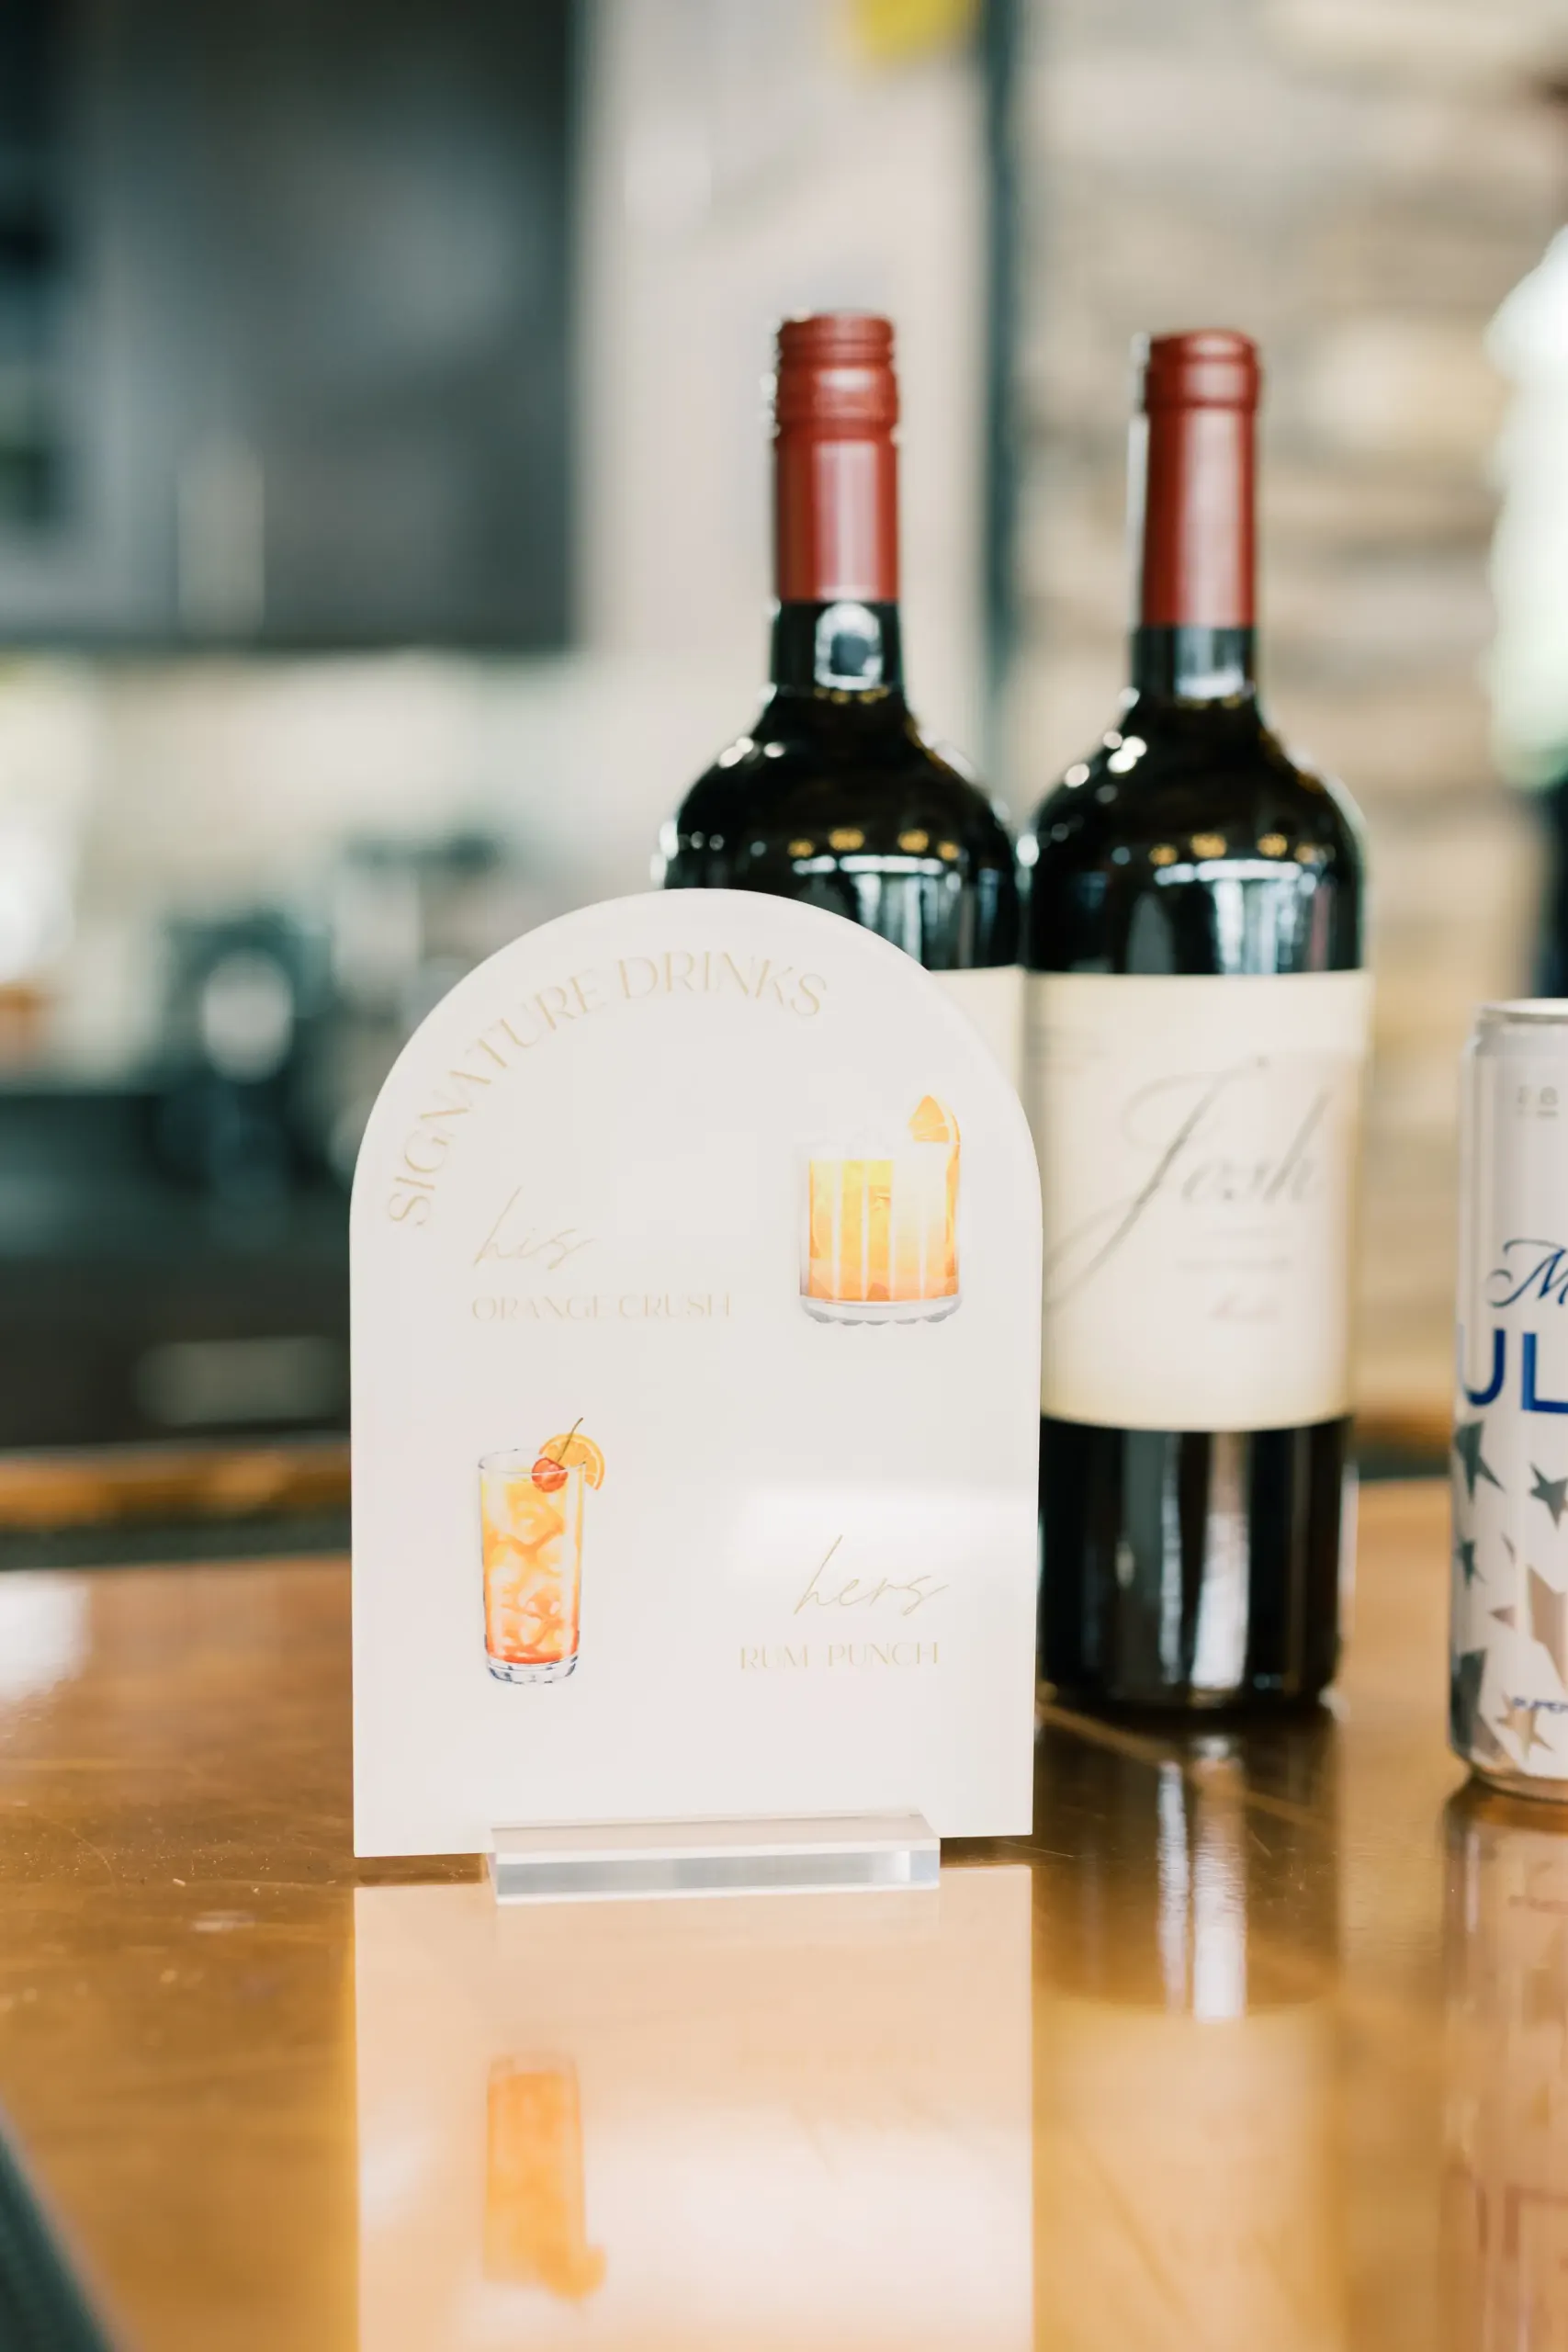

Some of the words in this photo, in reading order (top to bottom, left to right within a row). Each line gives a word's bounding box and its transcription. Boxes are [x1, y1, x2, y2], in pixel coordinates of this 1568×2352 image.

[387, 968, 606, 1227] SIGNATURE
[615, 950, 828, 1017] DRINKS
[472, 1185, 596, 1270] his
[471, 1295, 604, 1320] ORANGE
[618, 1292, 731, 1319] CRUSH
[793, 1533, 950, 1616] hers
[740, 1645, 809, 1669] RUM
[828, 1641, 939, 1668] PUNCH
